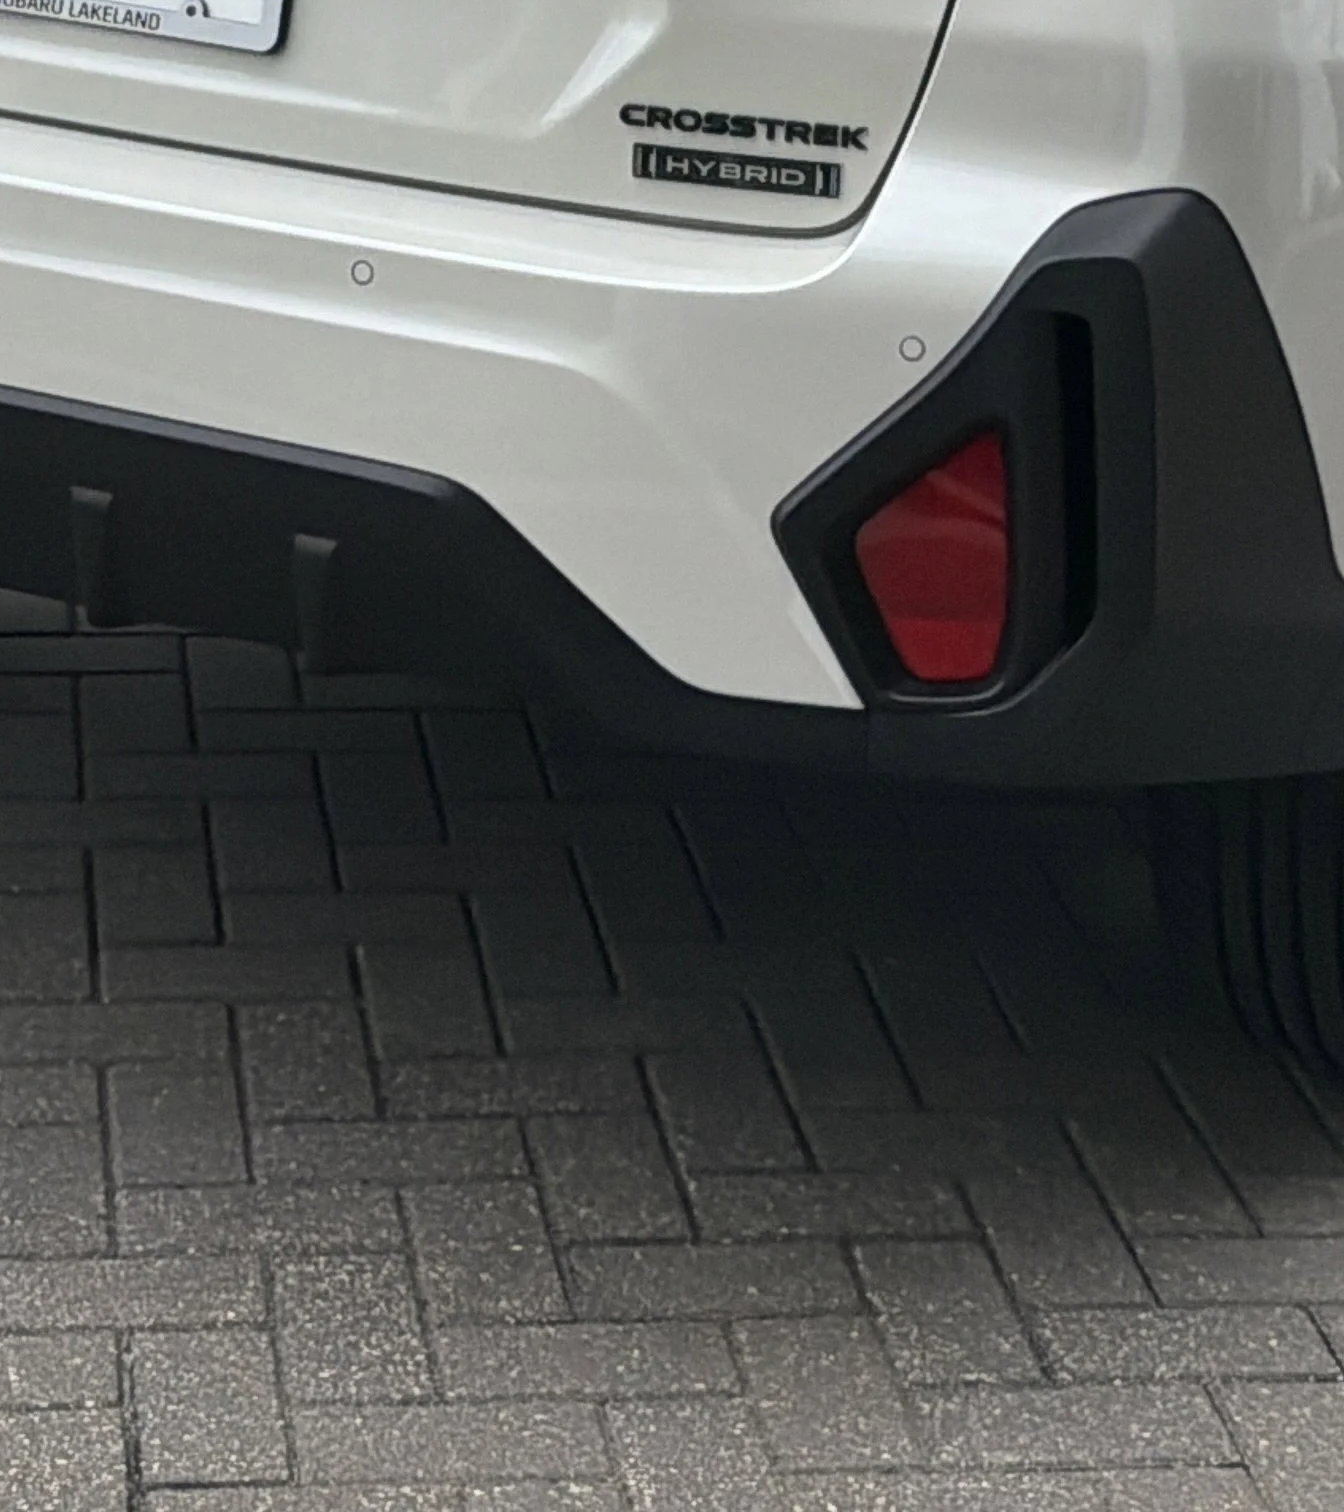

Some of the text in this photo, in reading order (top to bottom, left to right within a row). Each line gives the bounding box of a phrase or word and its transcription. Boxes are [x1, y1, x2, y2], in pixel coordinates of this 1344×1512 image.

[68, 0, 161, 32] LAKELAND
[619, 102, 869, 151] CROSSTREK
[665, 154, 807, 187] HYBRID
